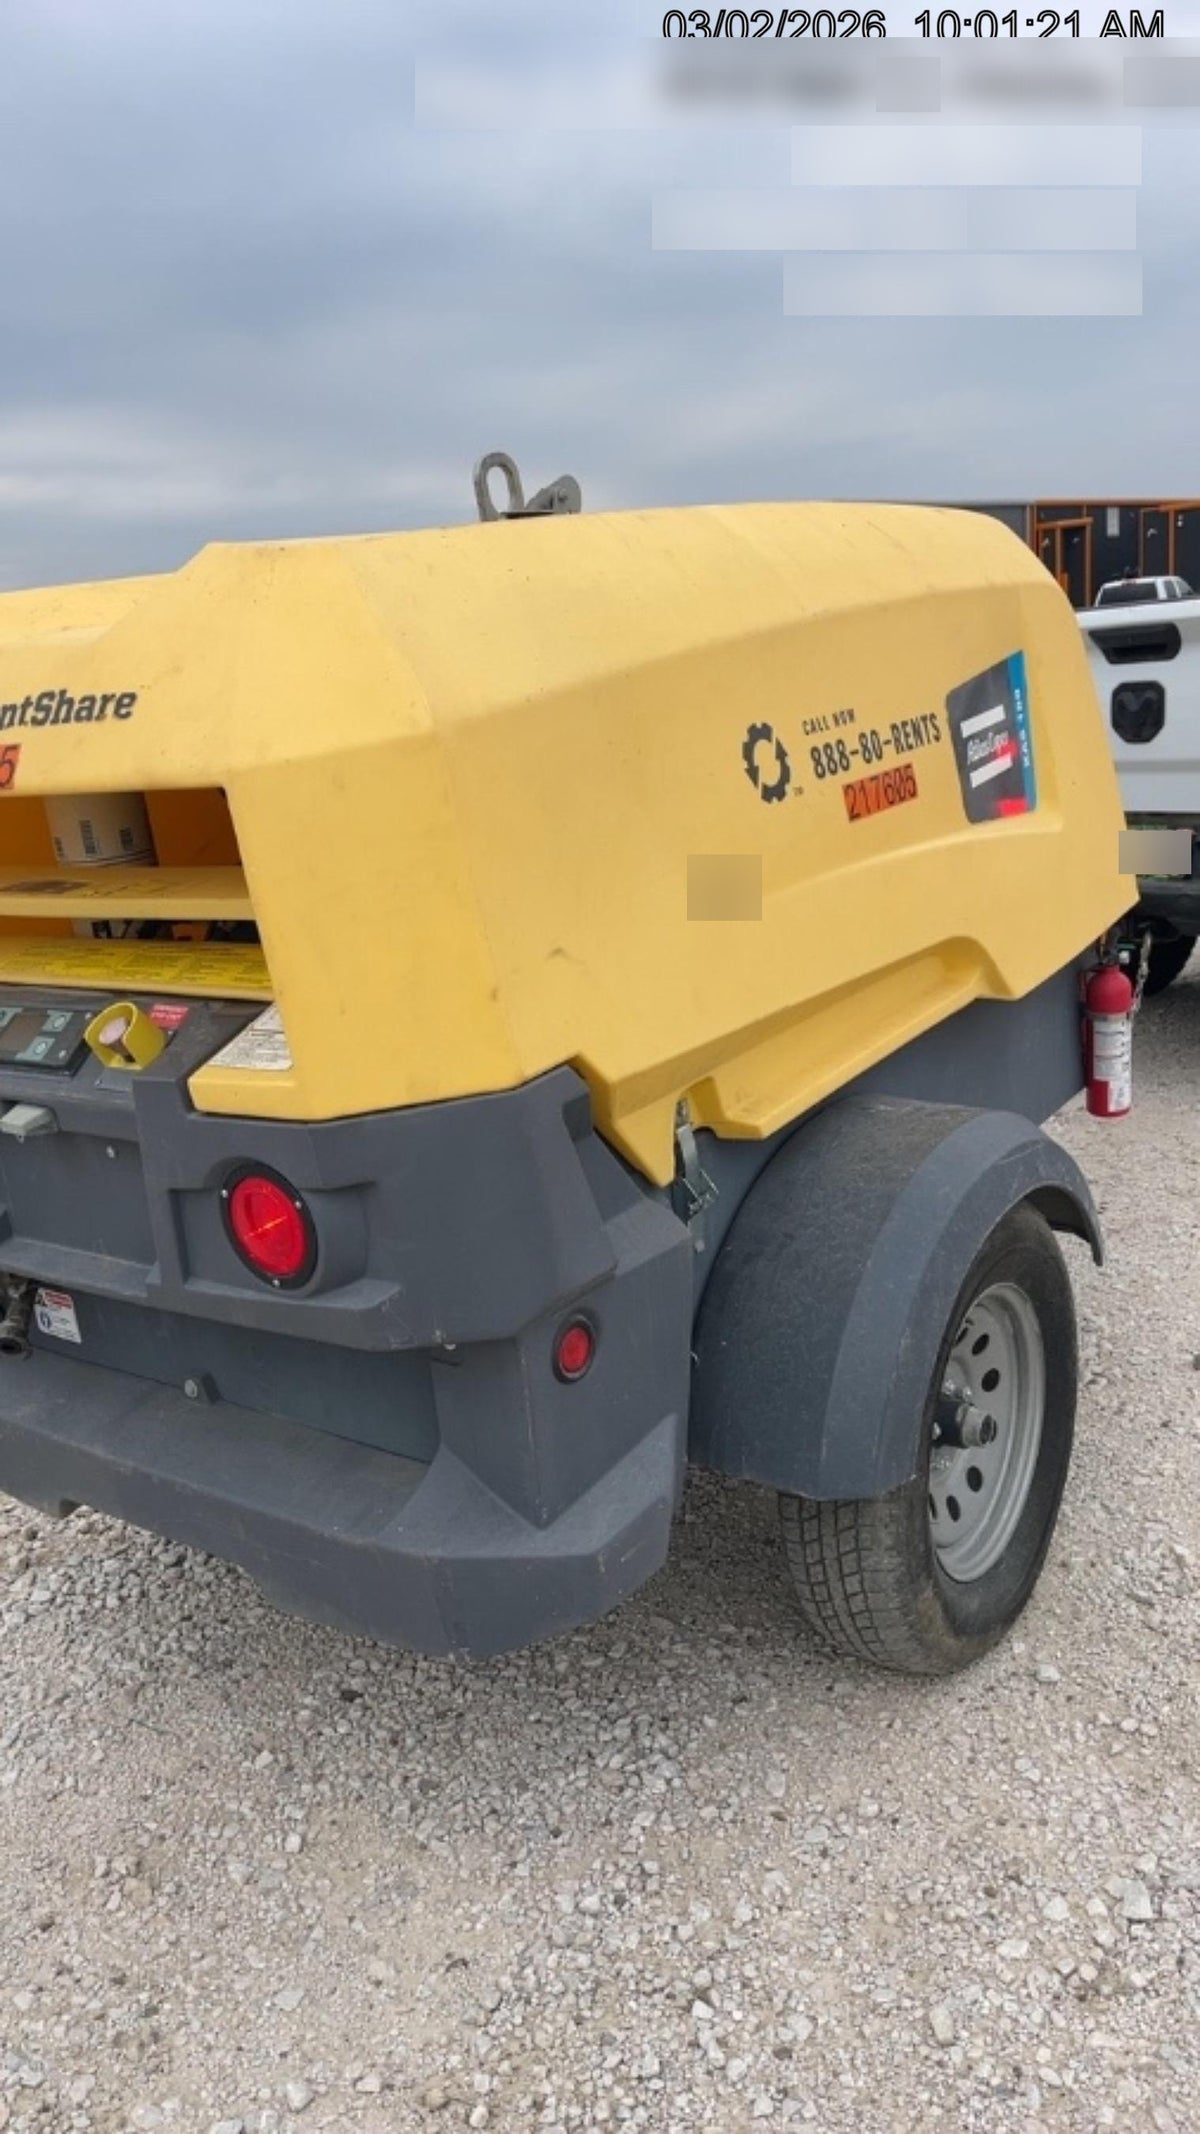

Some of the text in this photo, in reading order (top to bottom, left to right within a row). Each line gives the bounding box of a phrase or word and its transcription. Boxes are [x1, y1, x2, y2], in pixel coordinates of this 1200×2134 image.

[802, 708, 855, 735] CALL NOW
[810, 712, 941, 779] 888-80-RENTS
[843, 763, 917, 822] 217605
